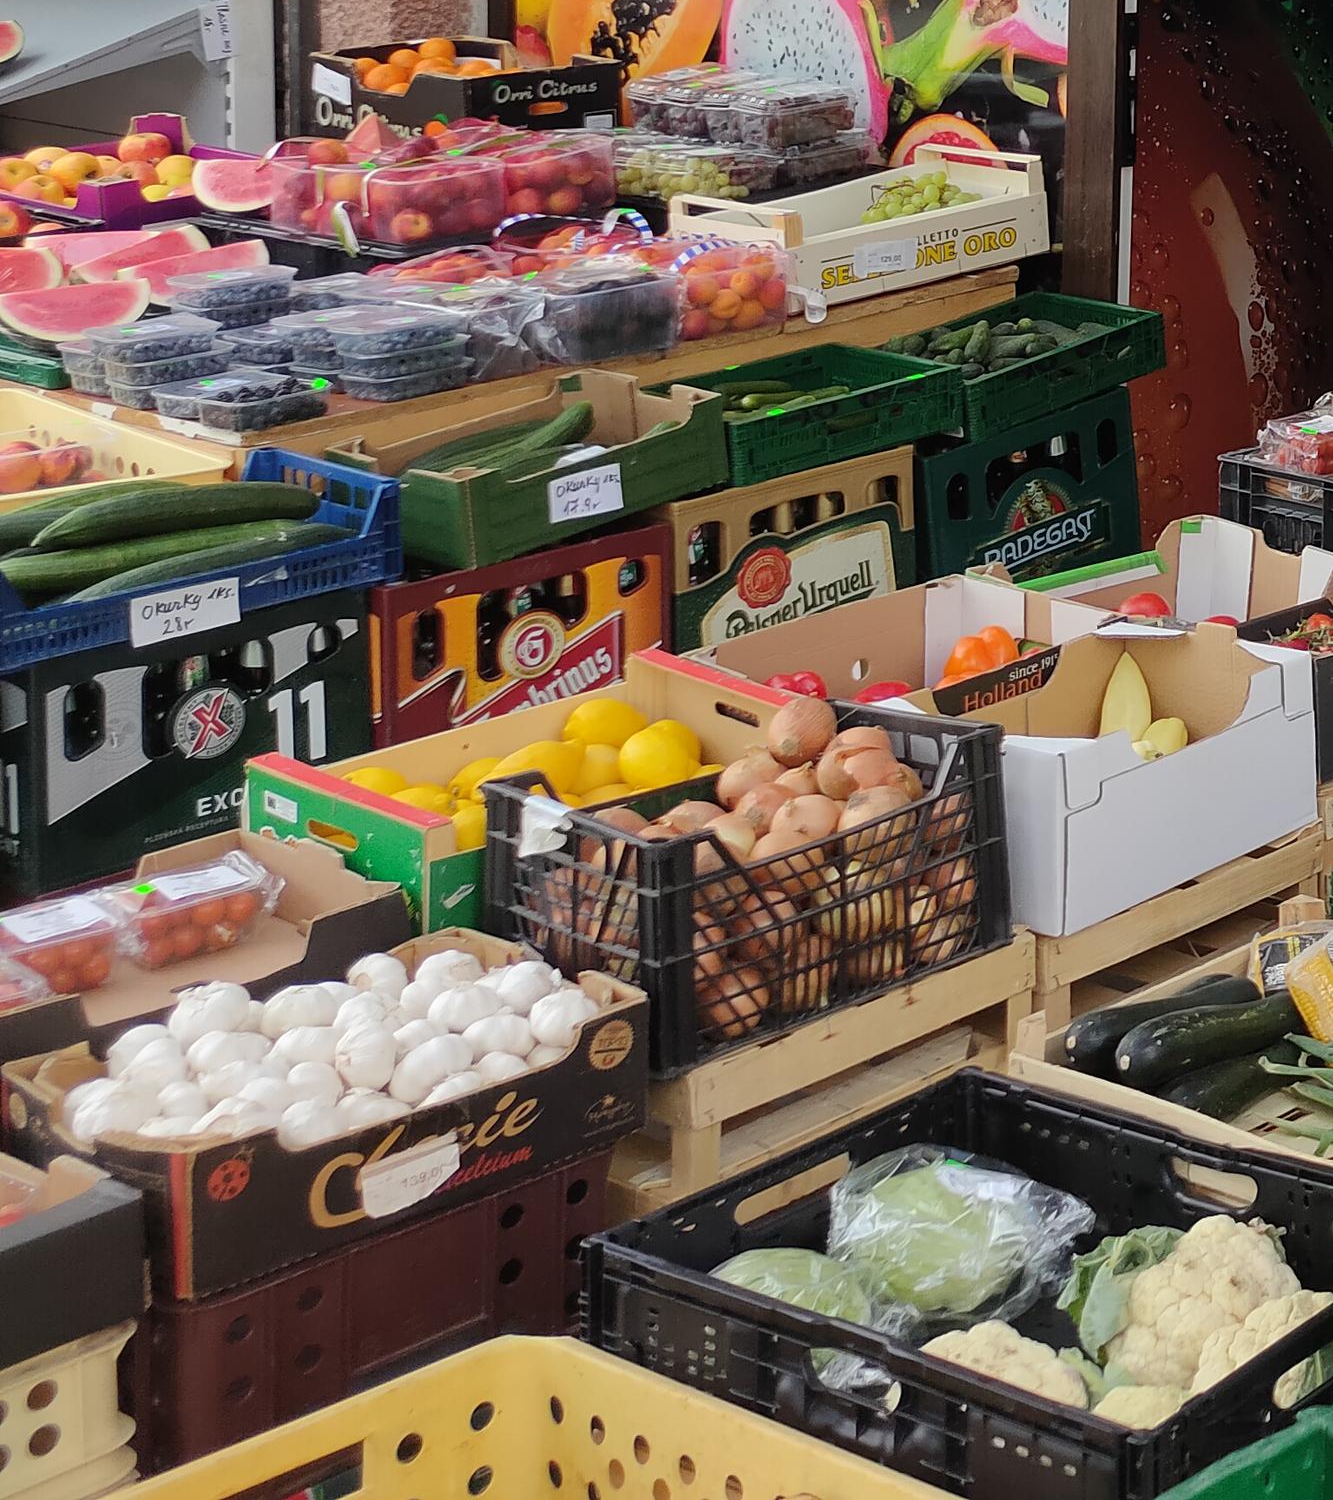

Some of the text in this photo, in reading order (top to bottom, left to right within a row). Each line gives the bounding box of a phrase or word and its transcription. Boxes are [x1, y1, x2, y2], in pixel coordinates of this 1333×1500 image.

[494, 79, 599, 104] Orri Citrus
[963, 226, 1018, 257] ORO
[798, 559, 873, 615] Urquell
[1009, 661, 1039, 682] since
[962, 671, 1043, 713] Holland
[268, 680, 328, 760] 11
